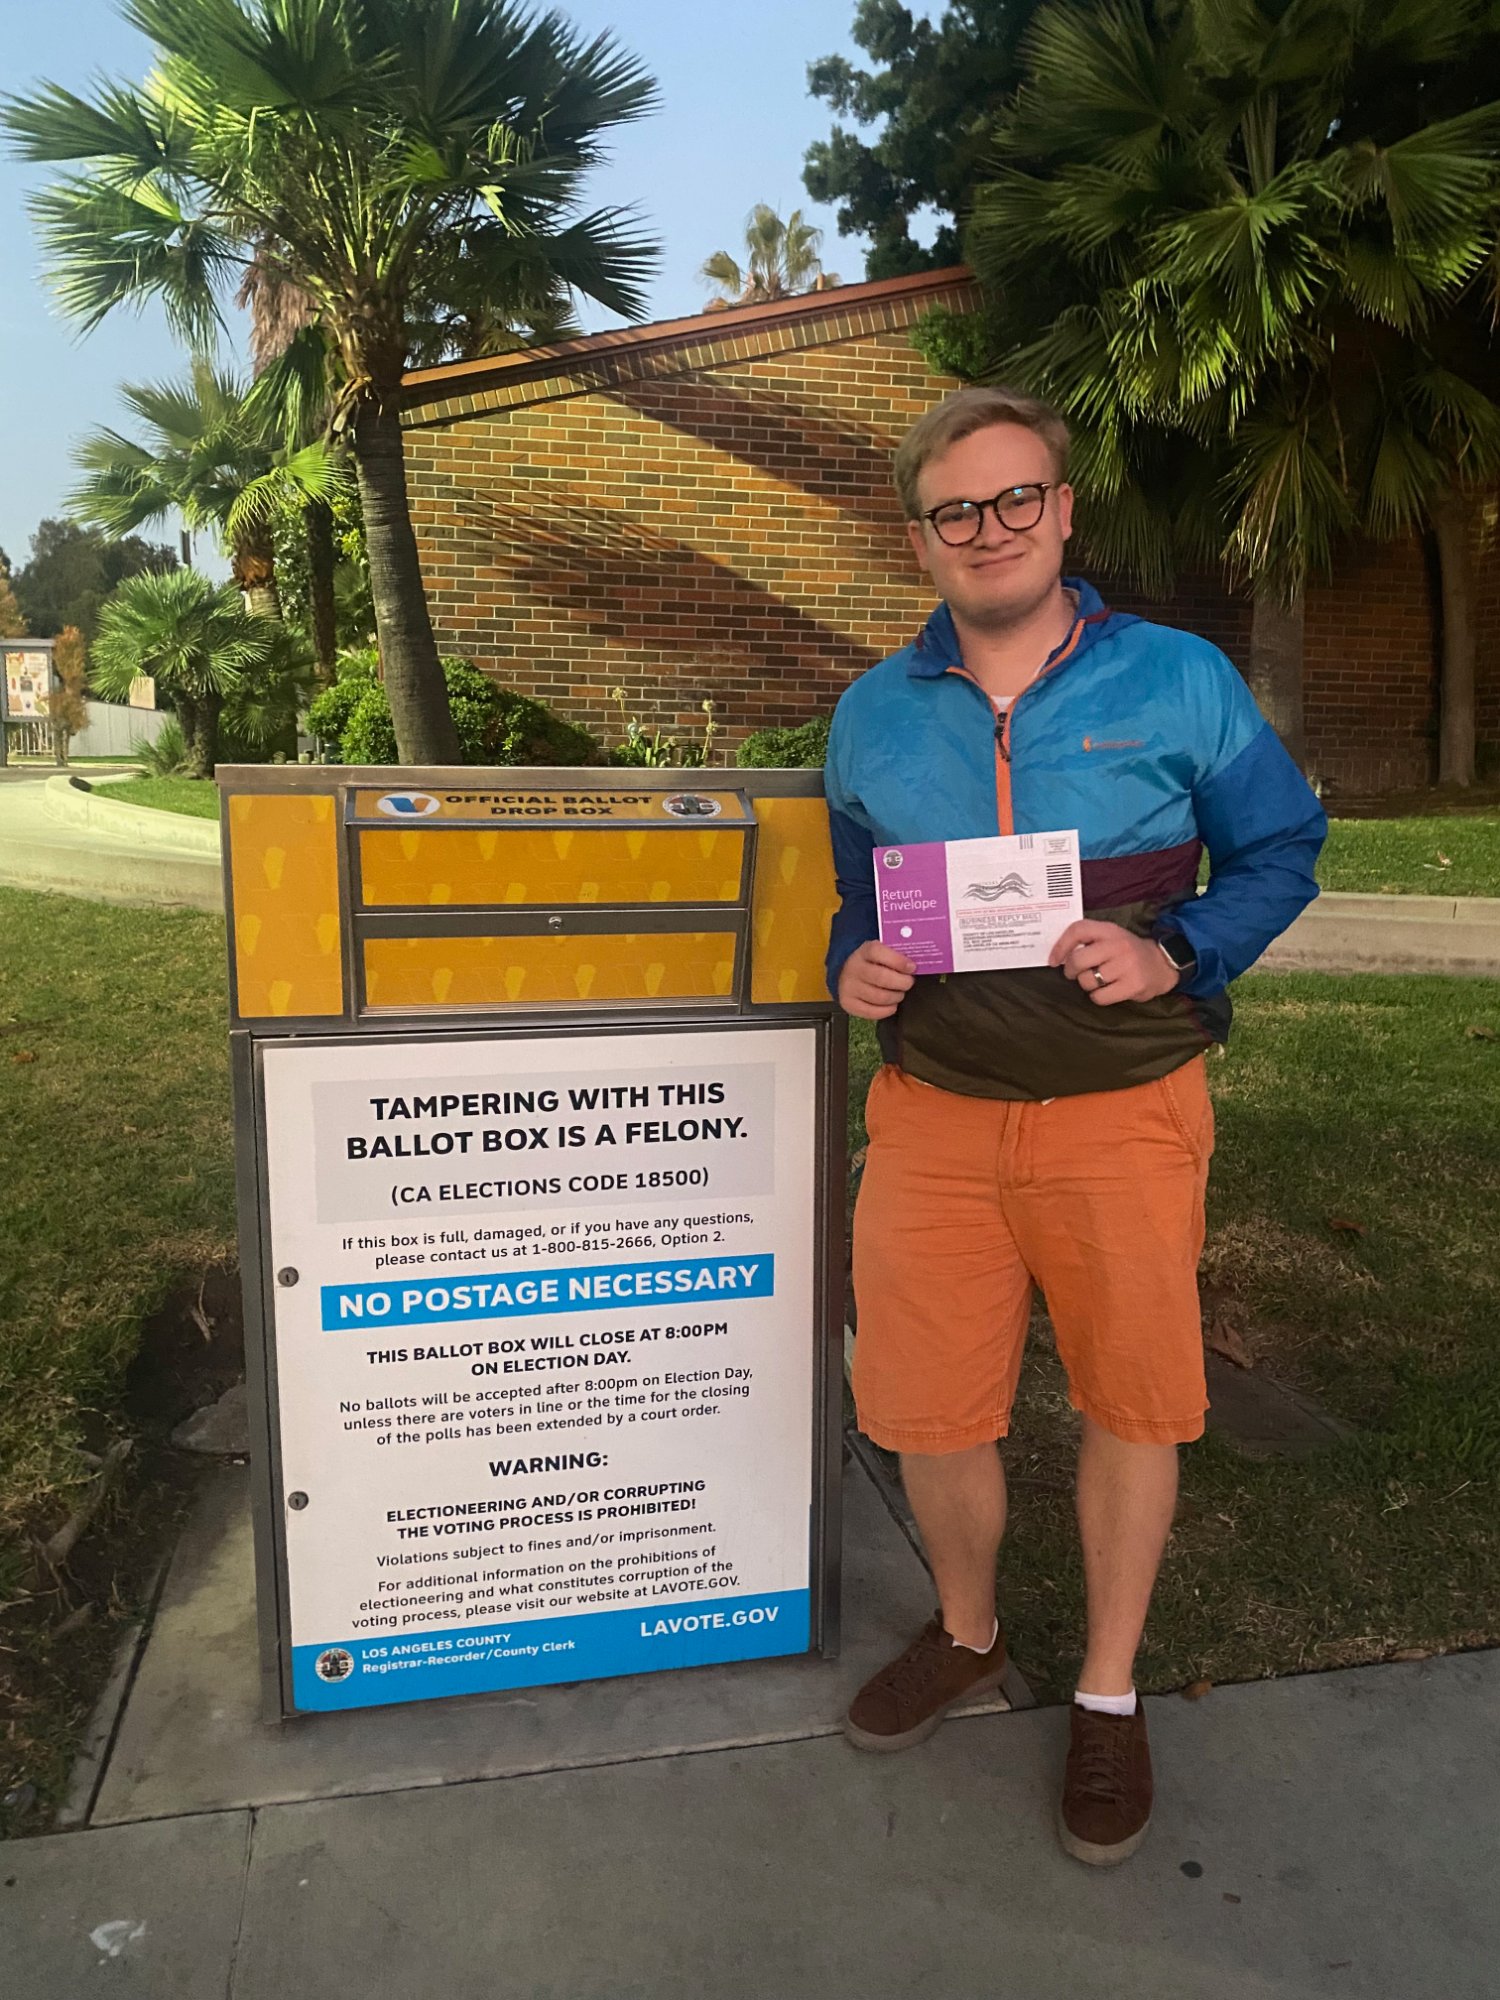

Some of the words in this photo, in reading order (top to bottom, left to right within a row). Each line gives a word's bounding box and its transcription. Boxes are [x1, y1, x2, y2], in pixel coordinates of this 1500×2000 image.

[445, 796, 557, 804] OFFICIAL
[563, 796, 652, 804] BALLOT
[491, 807, 557, 815] DROP
[564, 807, 613, 815] BOX
[882, 889, 922, 900] Return
[883, 899, 937, 912] Envelope
[370, 1090, 559, 1120] TAMPERING
[568, 1086, 649, 1110] WITH
[658, 1083, 725, 1106] THIS
[347, 1131, 473, 1159] BALLOT
[483, 1127, 549, 1152] BOX
[559, 1126, 586, 1148] IS
[595, 1124, 617, 1146] A
[626, 1117, 747, 1144] FELONY.
[392, 1185, 432, 1206] (CA
[439, 1178, 561, 1201] ELECTIONS
[569, 1174, 628, 1192] CODE
[636, 1167, 708, 1188] 18500)
[343, 1237, 353, 1250] If
[358, 1236, 386, 1249] this
[391, 1235, 418, 1246] box
[424, 1233, 435, 1244] is
[440, 1230, 468, 1243] full,
[474, 1225, 545, 1241] damaged,
[551, 1226, 566, 1235] or
[571, 1222, 580, 1234] if
[585, 1223, 610, 1236] you
[616, 1219, 649, 1231] have
[654, 1218, 679, 1230] any
[684, 1213, 753, 1229] questions,
[376, 1254, 425, 1269] please
[430, 1248, 486, 1262] contact
[492, 1248, 508, 1258] us
[513, 1245, 527, 1256] at
[533, 1235, 656, 1255] 1-800-815-2666,
[661, 1233, 708, 1248] Option
[713, 1231, 725, 1242] 2.
[340, 1292, 391, 1318] NO
[403, 1280, 558, 1313] POSTAGE
[569, 1264, 759, 1300] NECESSARY
[367, 1349, 408, 1364] THIS
[414, 1343, 483, 1360] BALLOT
[488, 1339, 525, 1354] BOX
[531, 1336, 574, 1350] WILL
[580, 1330, 635, 1346] CLOSE
[640, 1328, 661, 1341] AT
[471, 1362, 498, 1376] ON
[504, 1354, 588, 1373] ELECTION
[594, 1351, 631, 1365] DAY.
[340, 1401, 360, 1413] No
[366, 1397, 417, 1410] ballots
[422, 1393, 448, 1406] will
[453, 1392, 470, 1403] be
[476, 1384, 541, 1401] accepted
[546, 1383, 580, 1395] after
[585, 1378, 637, 1392] 8:00pm
[643, 1377, 659, 1386] on
[665, 1370, 720, 1384] Election
[725, 1368, 752, 1380] Day,
[344, 1417, 392, 1430] unless
[397, 1414, 435, 1426] there
[441, 1412, 464, 1422] are
[469, 1407, 514, 1419] voters
[520, 1404, 531, 1415] in
[537, 1402, 563, 1413] line
[568, 1401, 582, 1410] or
[587, 1397, 610, 1408] the
[615, 1394, 645, 1406] time
[650, 1391, 670, 1403] for
[674, 1389, 697, 1400] the
[701, 1385, 749, 1398] closing
[377, 1433, 391, 1445] of
[396, 1432, 420, 1443] the
[426, 1427, 461, 1444] polls
[466, 1426, 491, 1437] has
[497, 1423, 531, 1434] been
[537, 1414, 602, 1431] extended
[607, 1413, 623, 1426] by
[628, 1413, 636, 1422] a
[641, 1408, 677, 1421] court
[682, 1404, 720, 1417] order.
[489, 1452, 608, 1477] WARNING:
[387, 1498, 527, 1522] ELECTIONEERING
[531, 1491, 599, 1508] AND/OR
[604, 1480, 705, 1500] CORRUPTING
[397, 1526, 428, 1539] THE
[433, 1520, 495, 1535] VOTING
[500, 1511, 573, 1529] PROCESS
[578, 1509, 592, 1521] IS
[597, 1498, 696, 1519] PROHIBITED!
[377, 1552, 448, 1567] Violations
[453, 1545, 504, 1560] subject
[509, 1544, 523, 1553] to
[528, 1540, 561, 1551] fines
[566, 1533, 614, 1547] and/or
[620, 1522, 716, 1543] imprisonment.
[360, 1592, 463, 1611] electioneering
[468, 1586, 494, 1599] and
[499, 1583, 533, 1596] what
[538, 1576, 614, 1591] constitutes
[619, 1567, 689, 1582] corruption
[694, 1562, 707, 1574] of
[711, 1561, 733, 1572] the
[379, 1581, 401, 1592] For
[406, 1571, 478, 1589] additional
[483, 1564, 564, 1581] information
[569, 1562, 586, 1572] on
[591, 1558, 612, 1569] the
[618, 1550, 698, 1569] prohibitions
[702, 1545, 716, 1557] of
[352, 1615, 397, 1628] voting
[403, 1609, 461, 1626] process,
[466, 1603, 511, 1619] please
[516, 1598, 544, 1610] visit
[549, 1597, 572, 1606] our
[577, 1589, 629, 1603] website
[634, 1587, 647, 1597] at
[652, 1575, 740, 1595] LAVOTE.GOV.
[641, 1607, 778, 1637] LAVOTE.GOV
[362, 1648, 388, 1659] LOS
[392, 1640, 452, 1655] ANGELES
[456, 1634, 511, 1648] COUNTY
[363, 1646, 539, 1673] Registrar-Recorder/County
[542, 1640, 575, 1652] Clerk
